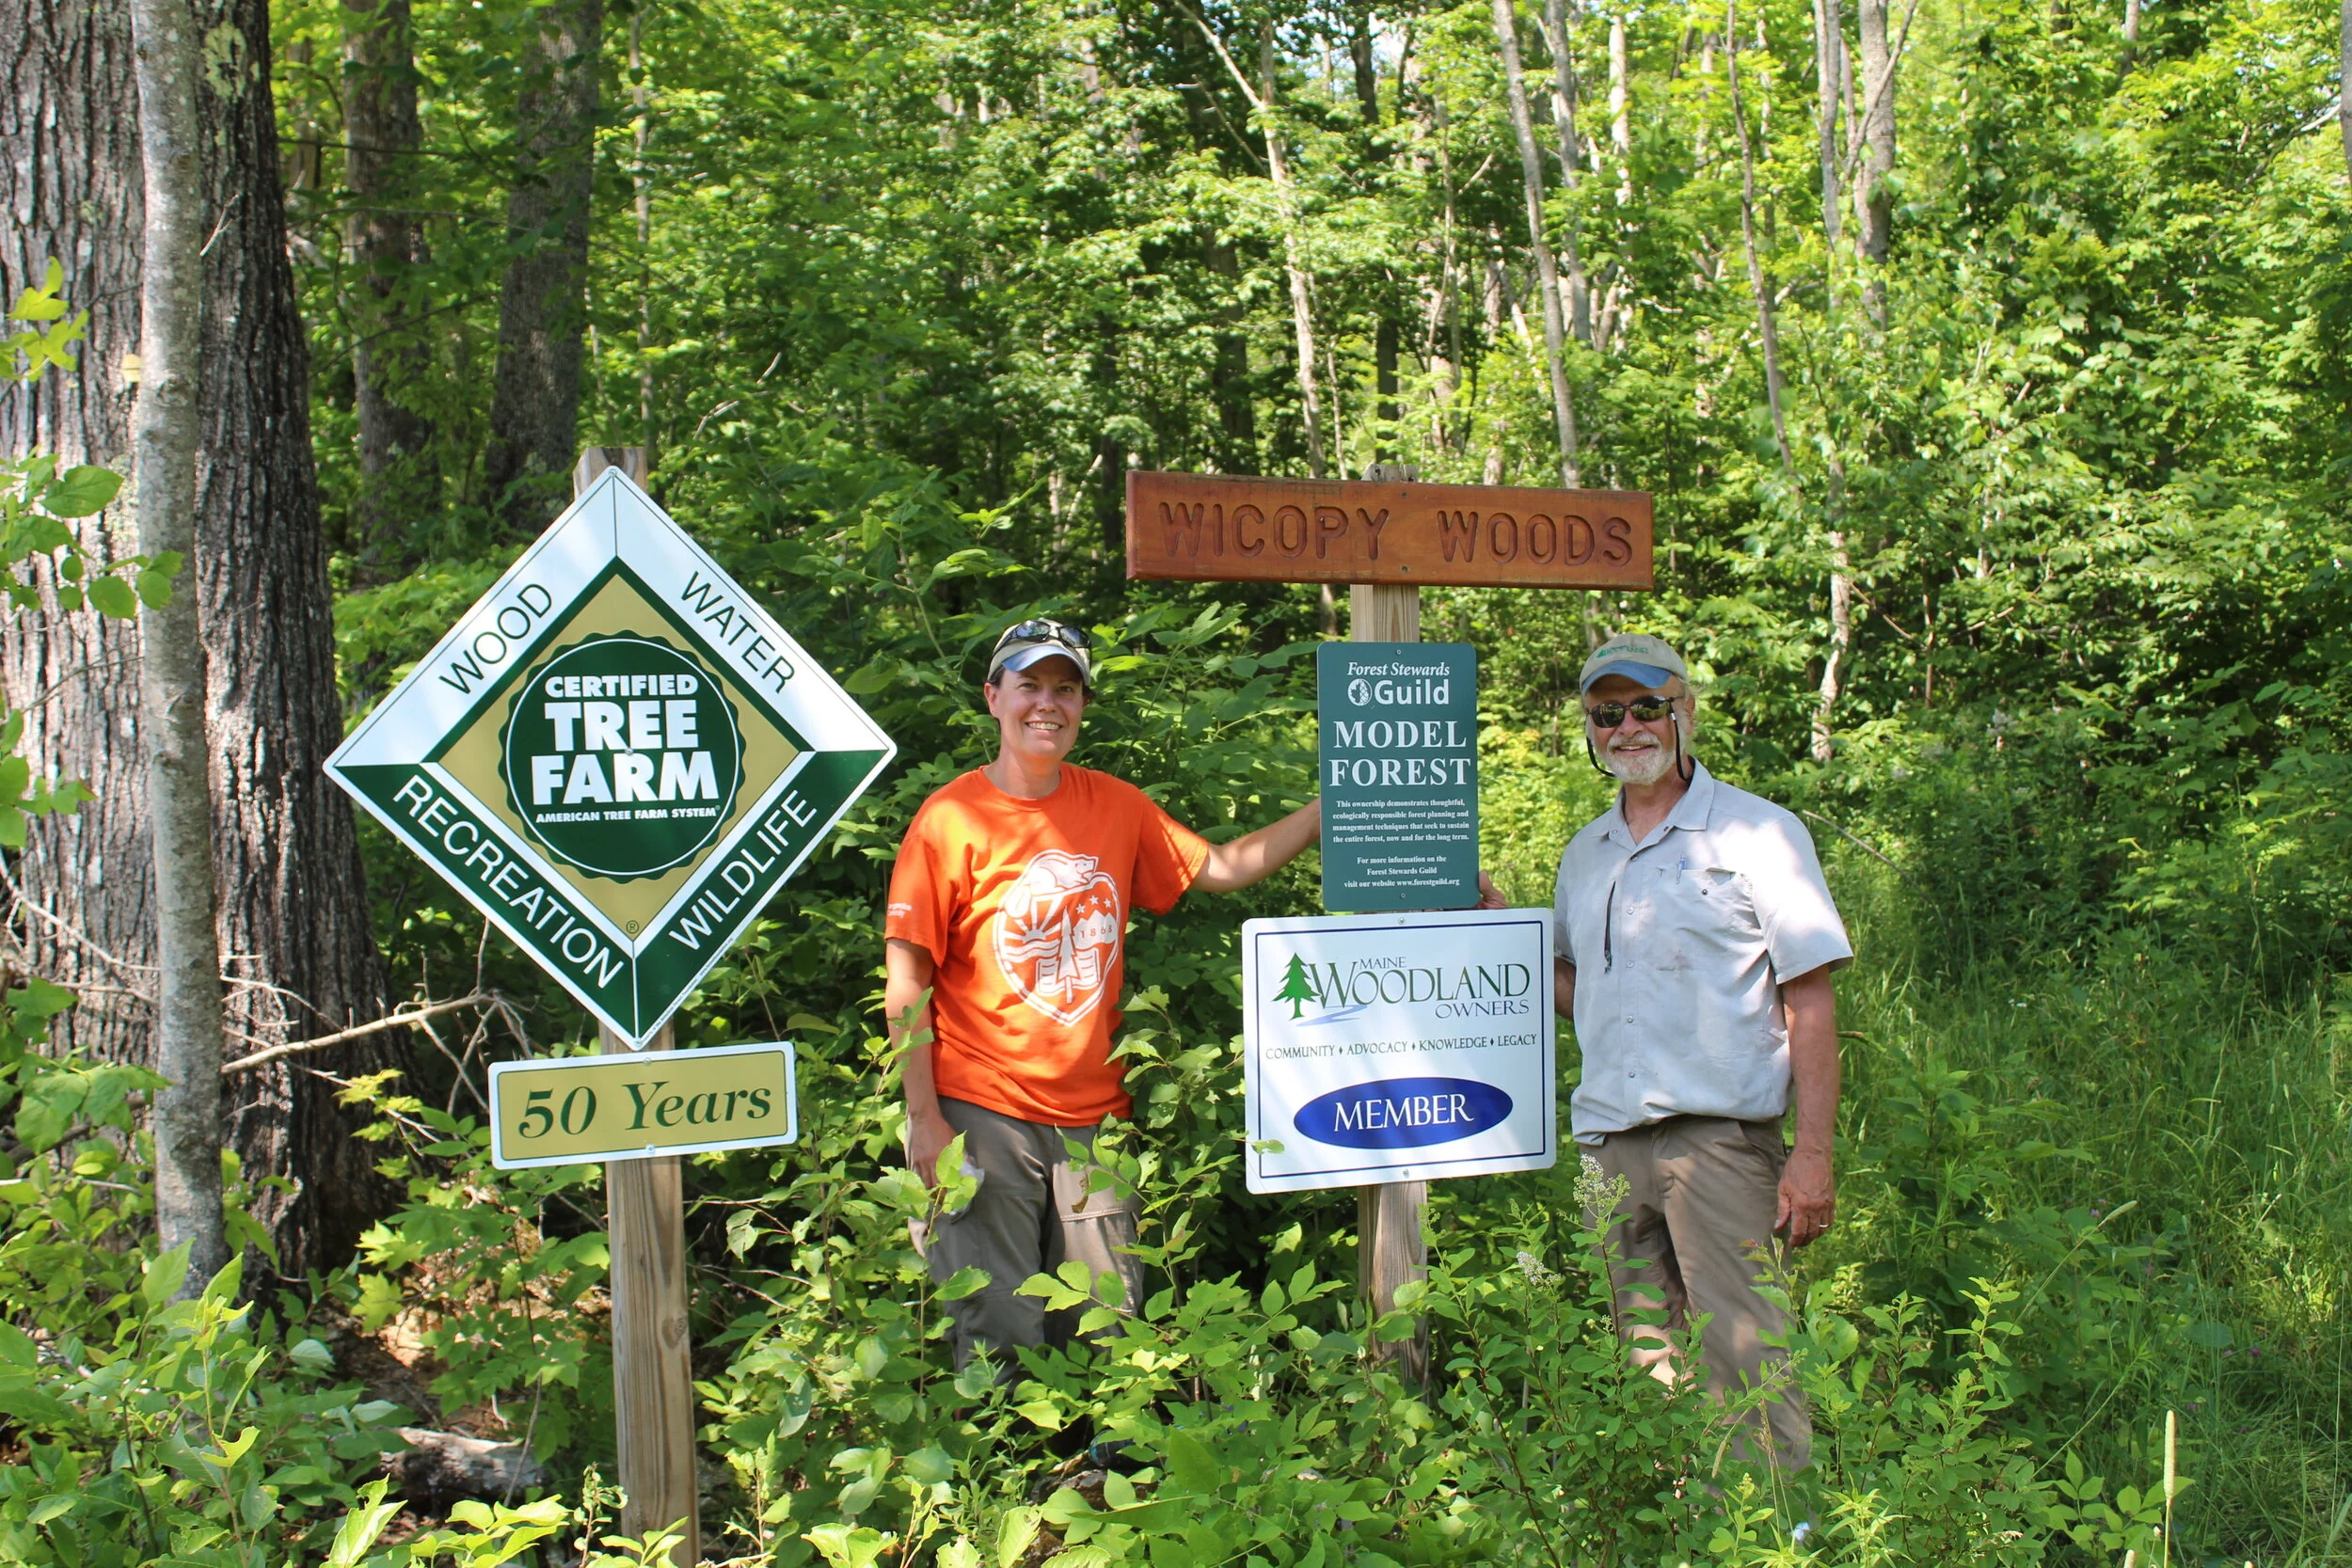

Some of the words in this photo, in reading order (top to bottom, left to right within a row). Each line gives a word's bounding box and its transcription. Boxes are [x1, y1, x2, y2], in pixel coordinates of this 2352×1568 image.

[1158, 501, 1390, 560] WICOPY
[1437, 510, 1633, 566] WOODS
[439, 582, 552, 696] WOOD
[680, 572, 796, 694] WATER
[1347, 661, 1388, 676] Forest
[1390, 661, 1451, 676] Stewards
[545, 673, 699, 698] CERTIFIED
[1375, 678, 1450, 705] Guild
[545, 700, 699, 752] TREE
[1333, 721, 1467, 749] MODEL
[532, 751, 719, 805] FARM
[1328, 758, 1471, 787] FOREST
[536, 812, 599, 823] AMERICAN
[603, 811, 631, 820] TREE
[635, 809, 668, 819] FARM
[1332, 812, 1369, 820] ecologically
[1371, 811, 1406, 819] responsible
[1427, 811, 1454, 819] planning
[1352, 800, 1385, 809] ownership
[1375, 823, 1408, 832] techniques
[1437, 833, 1451, 842] long
[668, 789, 817, 951] WILDLIFE
[1357, 856, 1369, 864] For
[392, 774, 624, 989] RECREATION
[1081, 926, 1112, 938] 1863
[1359, 956, 1406, 970] MAINE
[1309, 963, 1531, 1009] WOODLAND
[1435, 1000, 1530, 1019] OWNERS
[1265, 1045, 1336, 1060] COMMUNITY
[1346, 1040, 1407, 1055] ADVOCACY
[1419, 1037, 1488, 1051] KNOWLEDGE
[1498, 1034, 1537, 1047] LEGACY
[518, 1085, 597, 1139] 50
[623, 1081, 771, 1131] Years
[1334, 1094, 1474, 1132] MEMBER
